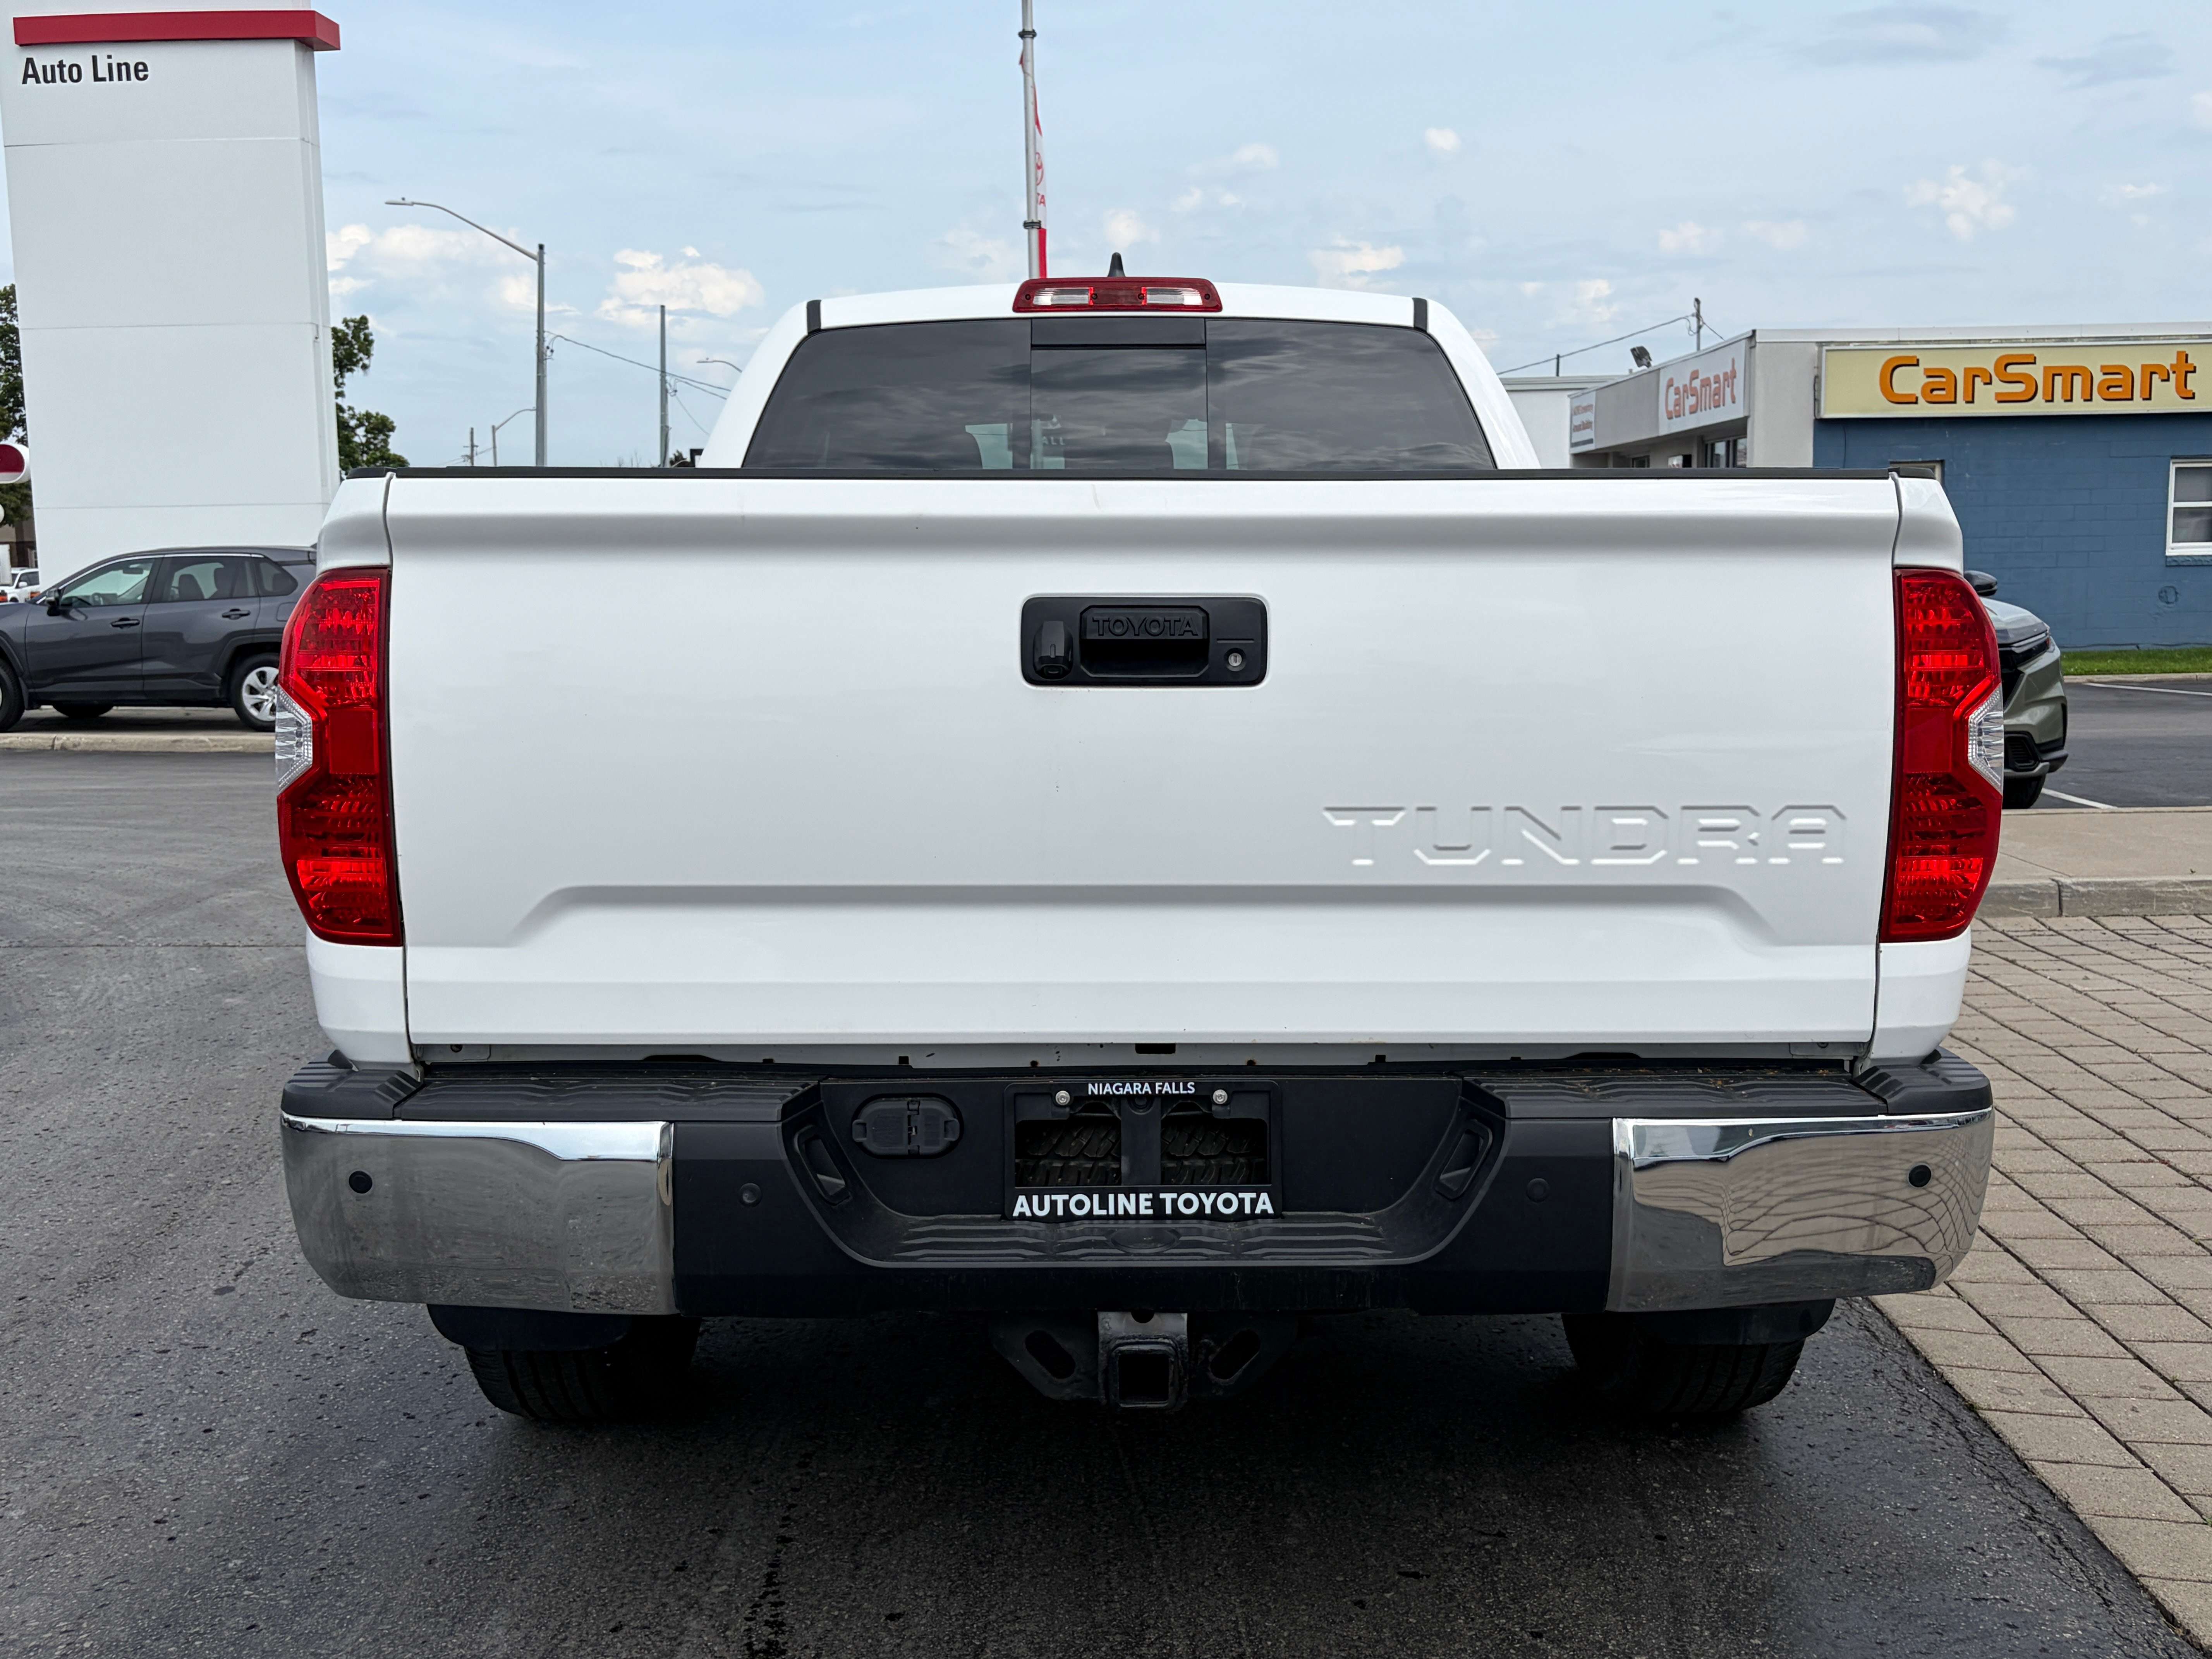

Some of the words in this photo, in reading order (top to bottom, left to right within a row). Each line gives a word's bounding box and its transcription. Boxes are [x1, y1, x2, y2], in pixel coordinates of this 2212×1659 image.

[22, 57, 82, 84] Auto
[91, 54, 149, 82] Line
[1666, 358, 1736, 419] CarSmart
[1879, 350, 2197, 405] CarSmart
[1092, 617, 1199, 636] TOYOTA
[1323, 805, 1846, 866] TUNDRA
[1088, 1083, 1151, 1095] NIAGARA
[1155, 1082, 1195, 1094] FALLS
[1013, 1193, 1154, 1217] AUTOLINE
[1159, 1192, 1274, 1214] TOYOTA
